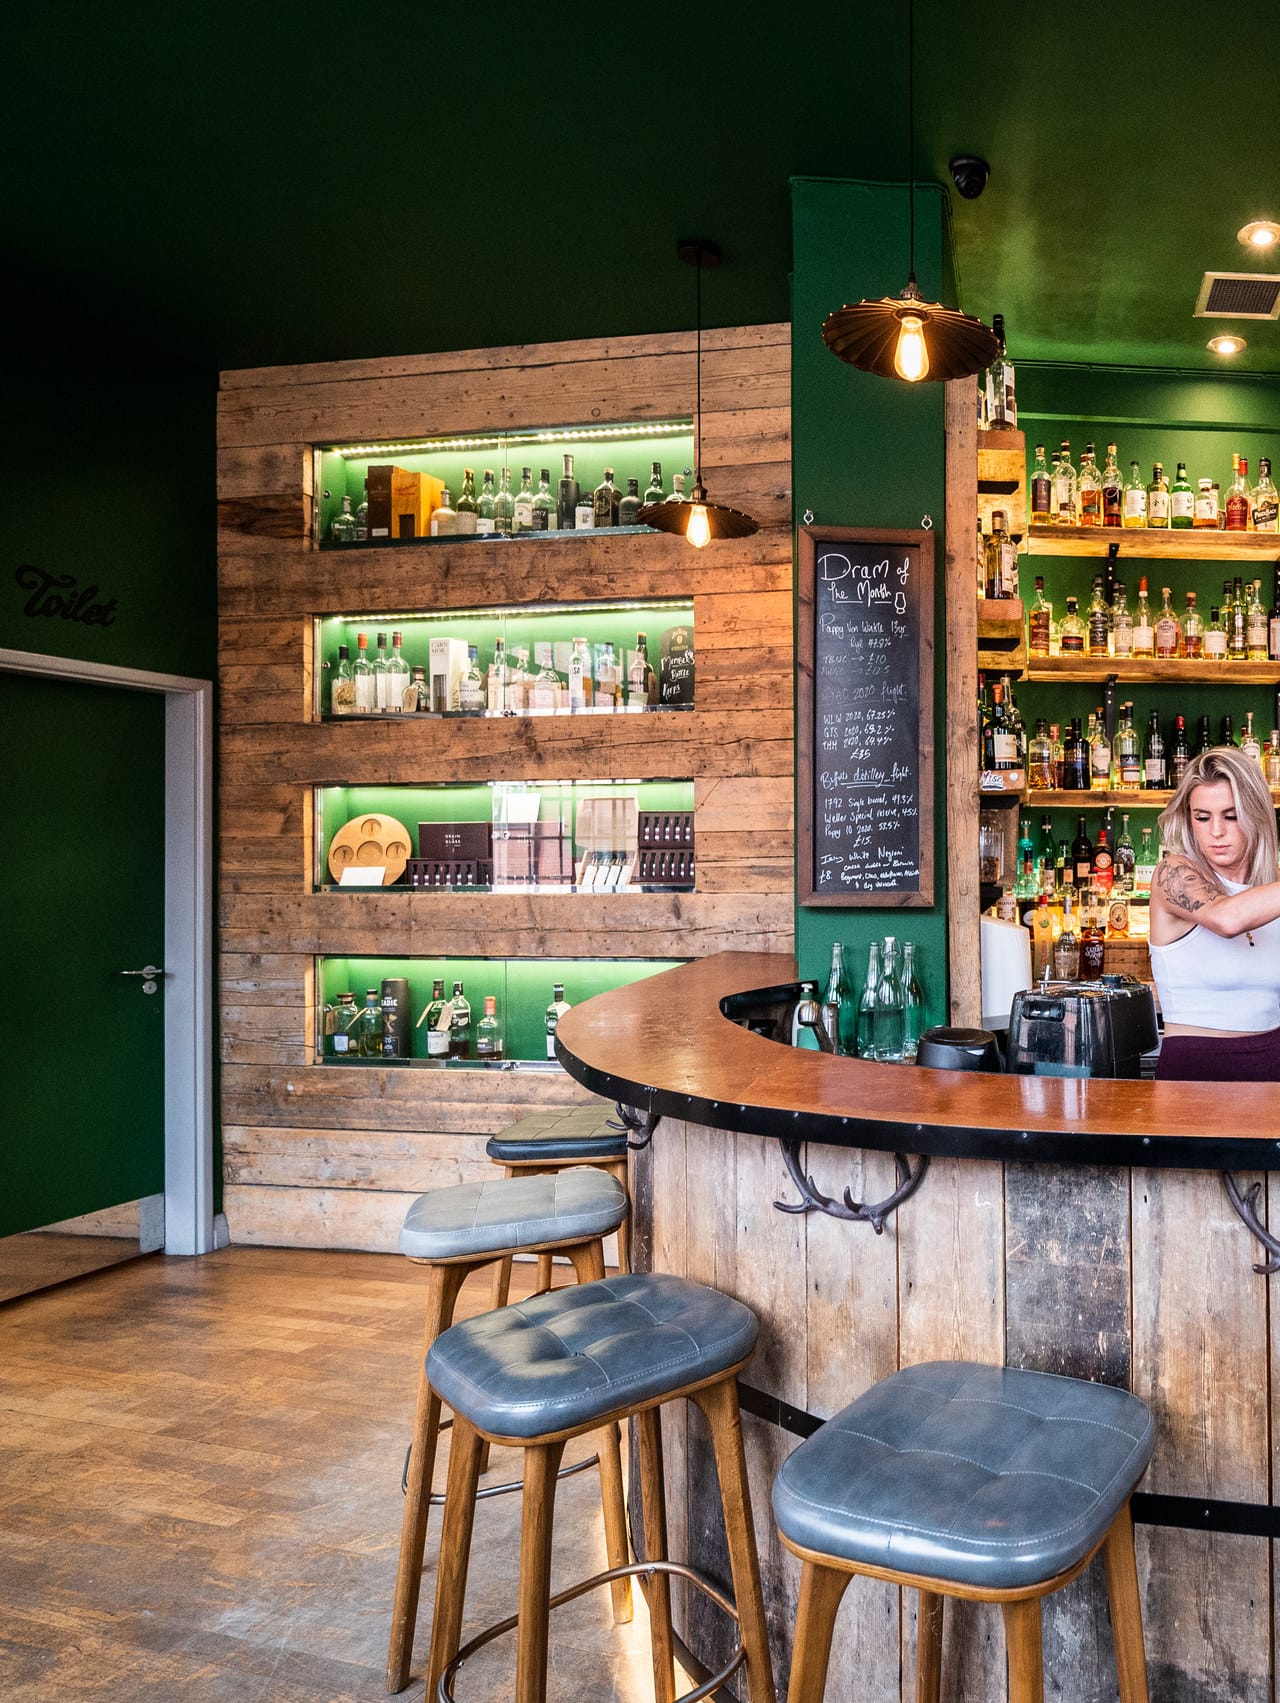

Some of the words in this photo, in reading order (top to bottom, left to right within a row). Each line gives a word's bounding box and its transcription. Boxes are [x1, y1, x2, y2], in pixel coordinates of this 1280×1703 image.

[818, 554, 889, 580] Dram
[897, 557, 909, 584] of
[16, 564, 118, 626] Toilet
[857, 580, 892, 607] Month
[819, 613, 844, 639] Pappy
[867, 653, 887, 665] £10
[850, 747, 871, 760] £35
[825, 797, 842, 809] 1792
[824, 813, 847, 823] Weller
